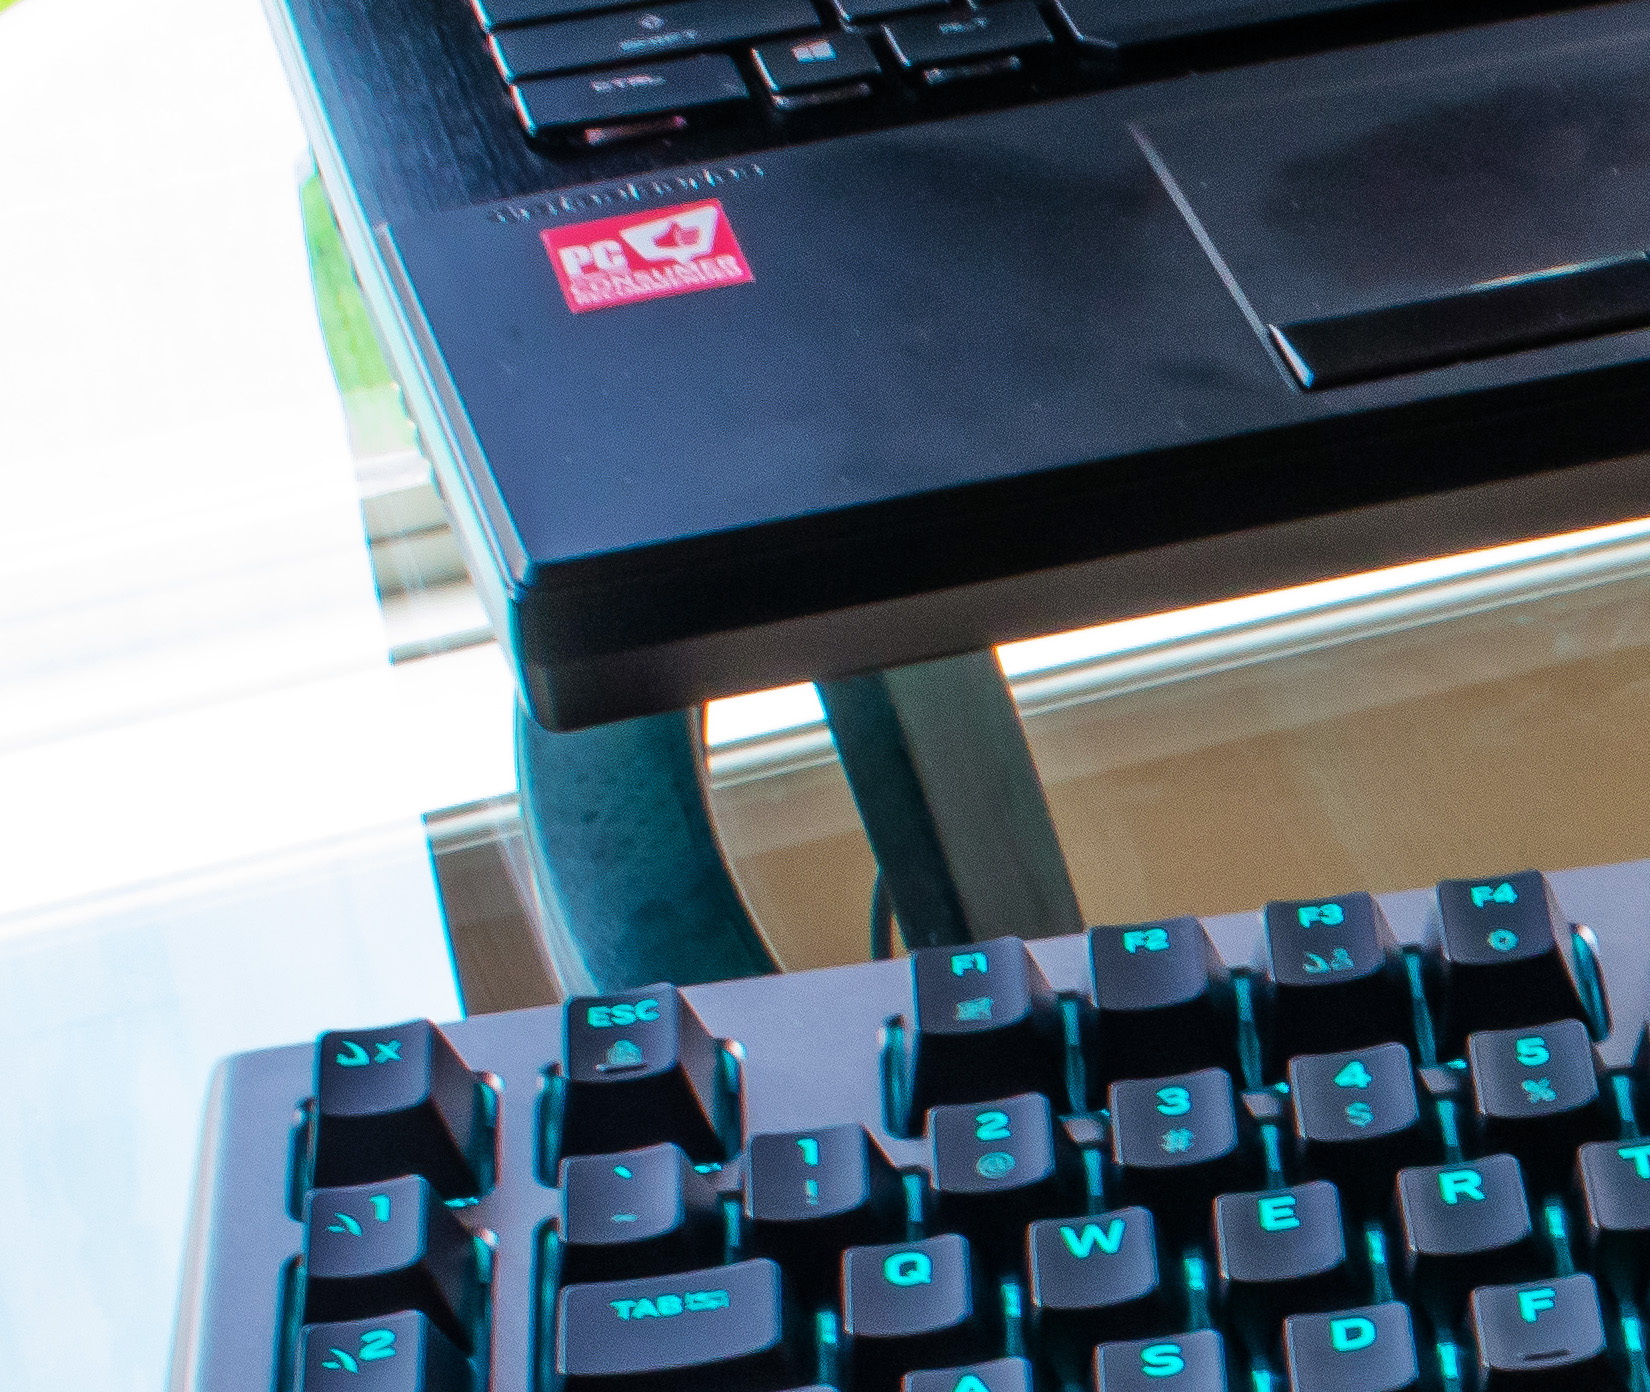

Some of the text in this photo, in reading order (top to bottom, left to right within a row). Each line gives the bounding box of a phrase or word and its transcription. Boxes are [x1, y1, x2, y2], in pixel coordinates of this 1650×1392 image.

[559, 239, 625, 277] PC
[1470, 882, 1519, 909] F4
[1123, 927, 1170, 954] F2
[951, 951, 989, 977] F1
[587, 998, 660, 1028] ESC
[1516, 1036, 1550, 1067] 5
[1334, 1060, 1373, 1089] 4
[1156, 1086, 1192, 1116] 3
[975, 1110, 1012, 1141] 2
[796, 1137, 820, 1167] 1
[1438, 1169, 1486, 1205] R
[370, 1193, 391, 1223] 1
[1258, 1195, 1301, 1232] E
[1060, 1218, 1126, 1259] W
[884, 1251, 932, 1287] Q
[610, 1293, 682, 1320] TAB
[1518, 1287, 1556, 1323] F
[358, 1328, 396, 1362] 2
[1330, 1317, 1377, 1352] D
[1141, 1343, 1185, 1378] S
